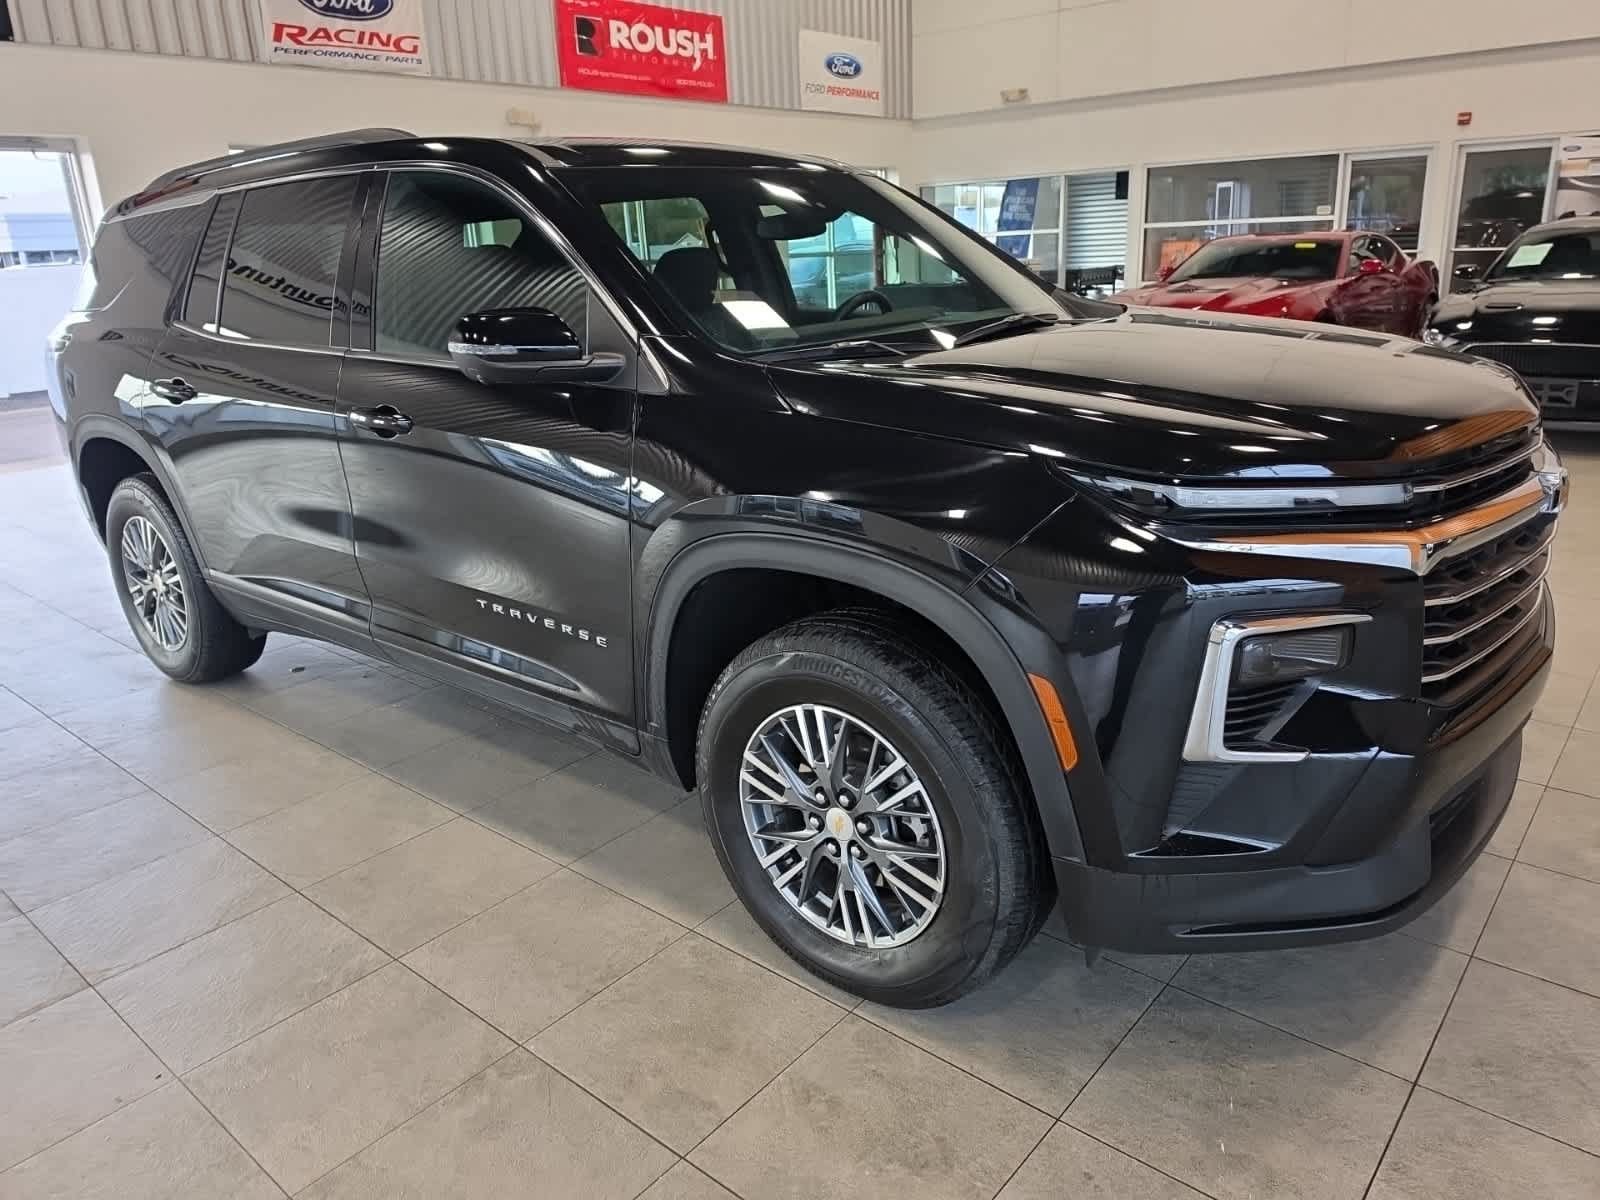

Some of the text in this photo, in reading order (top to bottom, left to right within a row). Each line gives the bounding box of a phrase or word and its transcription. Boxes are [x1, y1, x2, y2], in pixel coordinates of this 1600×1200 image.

[272, 22, 421, 55] RACING
[608, 19, 715, 71] ROUSH
[273, 46, 423, 65] PERFORMANCE PARTS
[831, 56, 857, 75] Ford
[805, 82, 880, 102] FORD PERFORMANCE
[476, 599, 609, 648] TRAVERSE
